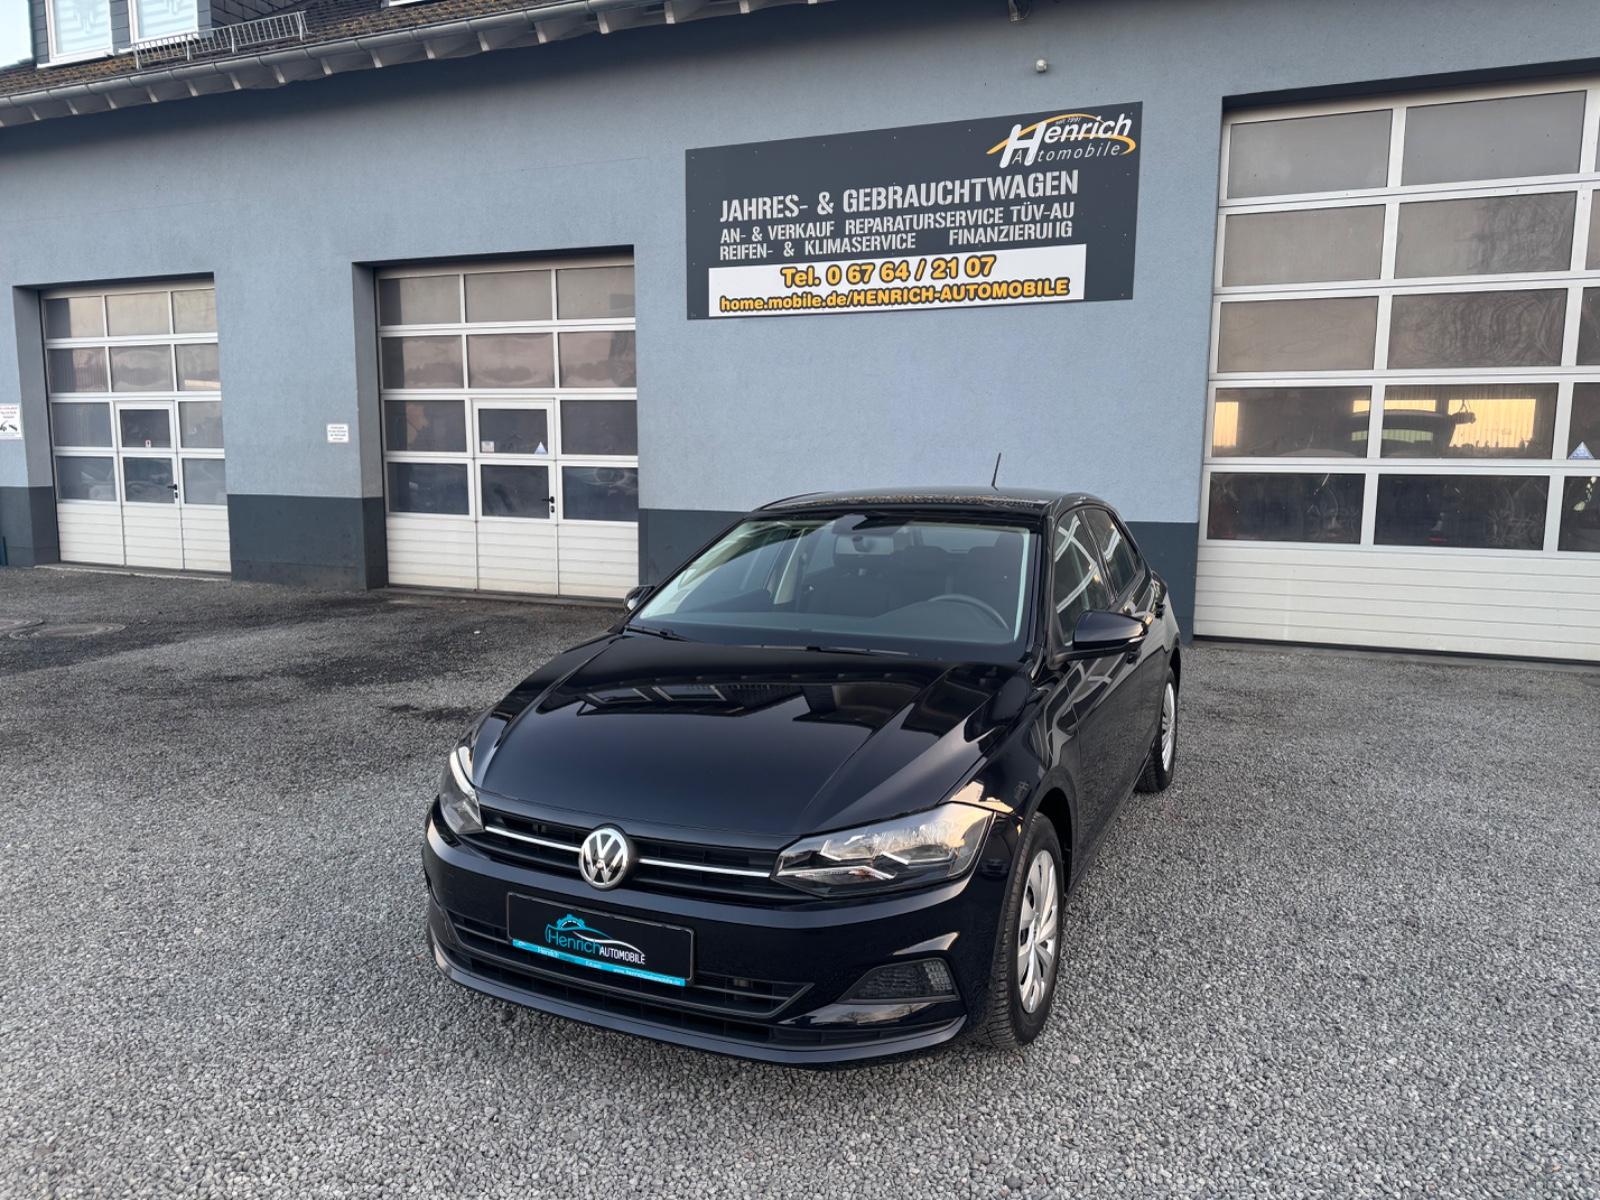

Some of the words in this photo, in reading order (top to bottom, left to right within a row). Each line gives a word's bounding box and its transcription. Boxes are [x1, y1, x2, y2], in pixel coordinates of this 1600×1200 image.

[999, 113, 1133, 168] Henrich
[1011, 142, 1121, 165] Atomobile
[720, 194, 808, 222] JAHRES-
[817, 191, 834, 215] &
[843, 169, 1079, 213] GEBRAUCHTWAGEN
[720, 227, 746, 244] AN-
[752, 226, 763, 242] &
[768, 221, 835, 240] VERKAUF
[845, 207, 1004, 236] REPARATURSERVICE
[1010, 201, 1075, 223] TÜV-AU
[720, 243, 773, 261] REIFEN-
[783, 241, 795, 257] &
[805, 232, 916, 256] KLIMASERVICE
[780, 264, 821, 288] Tel.
[826, 264, 842, 286] 0
[846, 262, 875, 285] 67
[879, 259, 911, 283] 64
[914, 257, 927, 282] /
[931, 256, 959, 280] 21
[965, 253, 997, 279] 07
[719, 276, 1071, 313] home.mobile.de/HENRICH-AUTOMOBILE
[547, 925, 600, 954] Henrich
[599, 945, 646, 966] AUTOMOBILE
